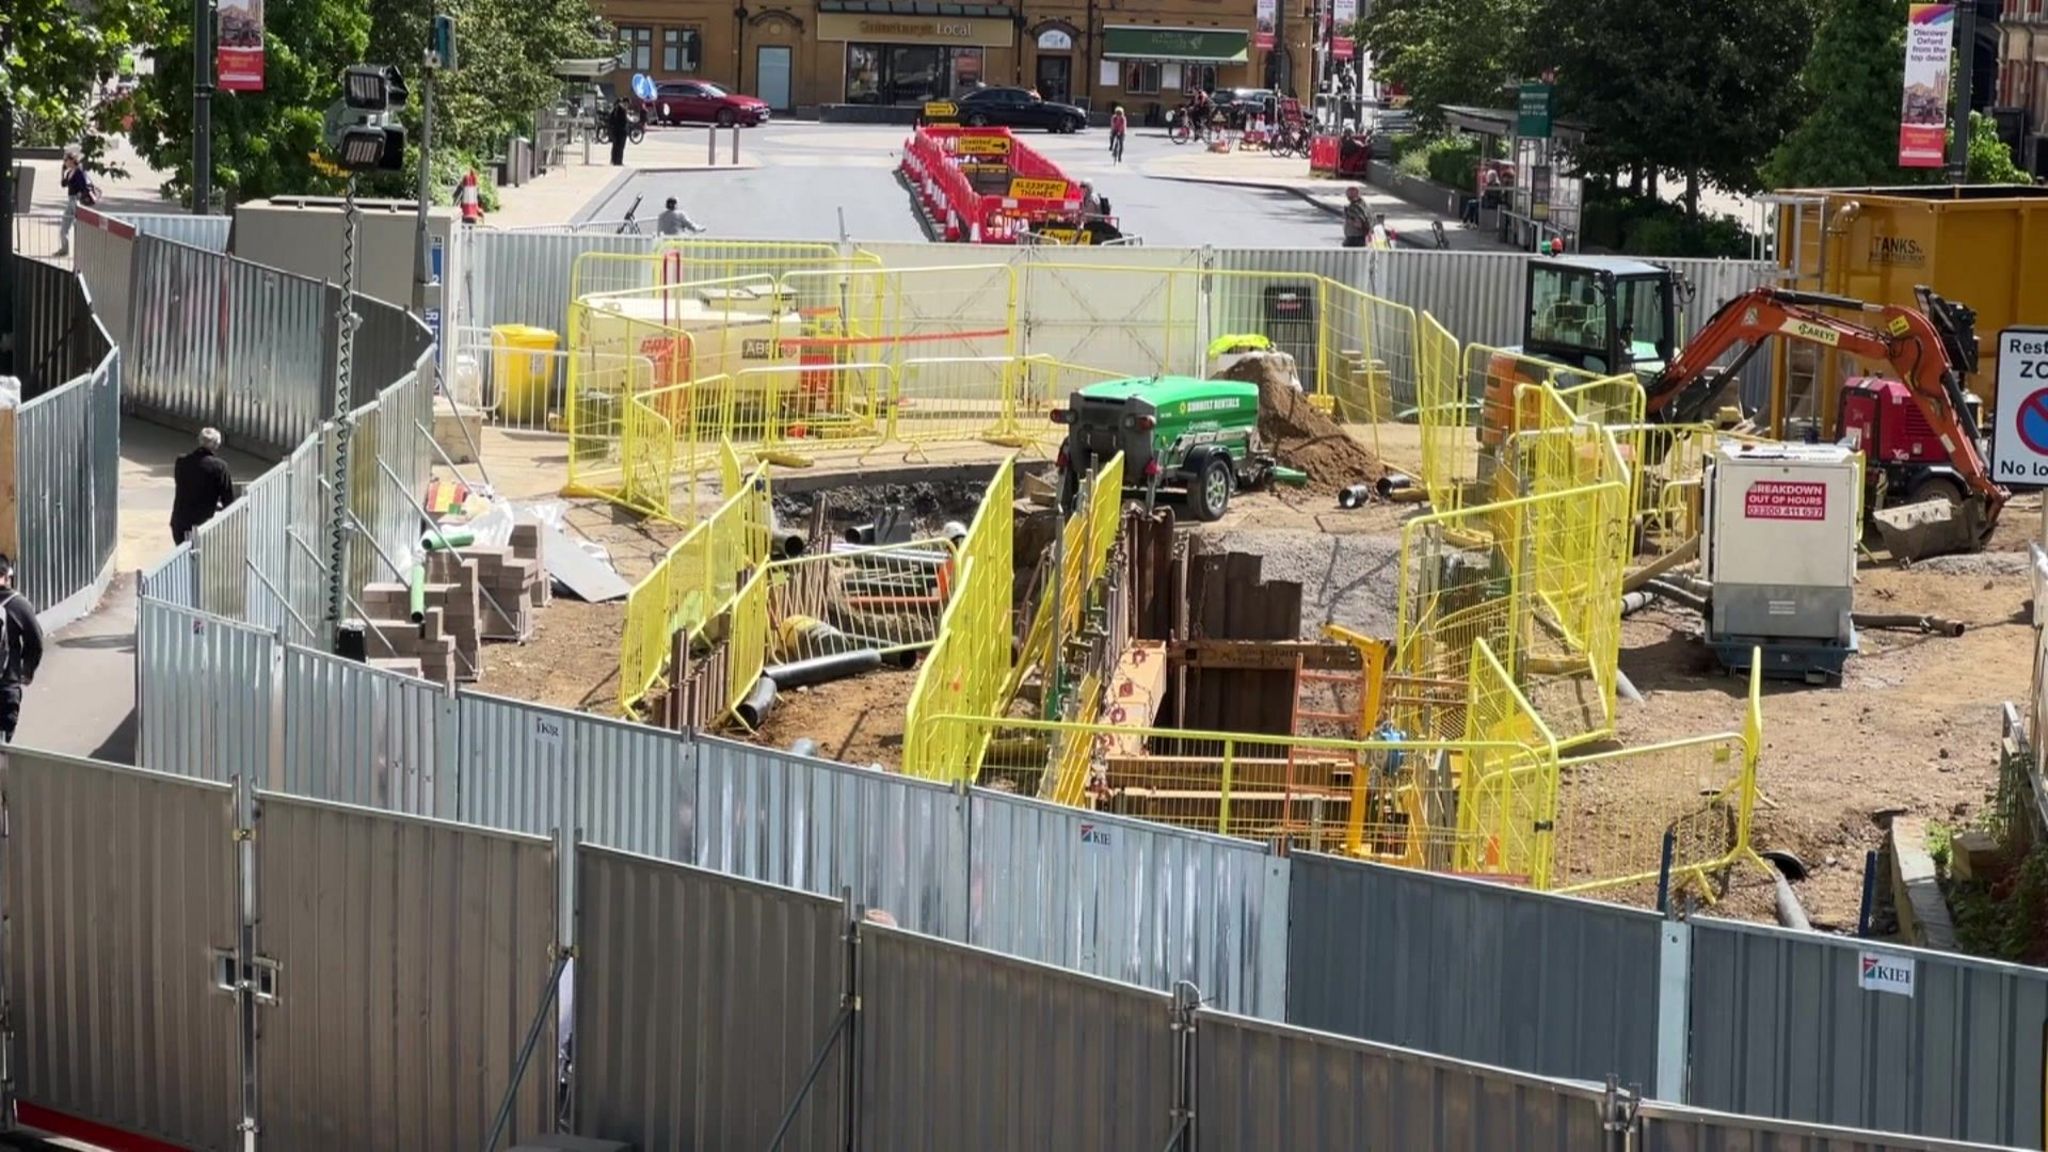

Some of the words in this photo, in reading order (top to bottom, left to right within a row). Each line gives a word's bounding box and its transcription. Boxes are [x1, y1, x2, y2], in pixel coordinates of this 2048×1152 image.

[936, 22, 973, 37] Local
[1917, 37, 1943, 45] Oxford
[1933, 46, 1947, 54] the
[1911, 54, 1923, 62] top
[1925, 54, 1947, 62] deck!
[1874, 236, 1916, 254] TANKS
[1798, 321, 1836, 342] CAREYS
[2001, 460, 2026, 476] No
[1749, 495, 1770, 503] OUT
[1772, 496, 1786, 504] OF
[1787, 497, 1822, 505] HOURS
